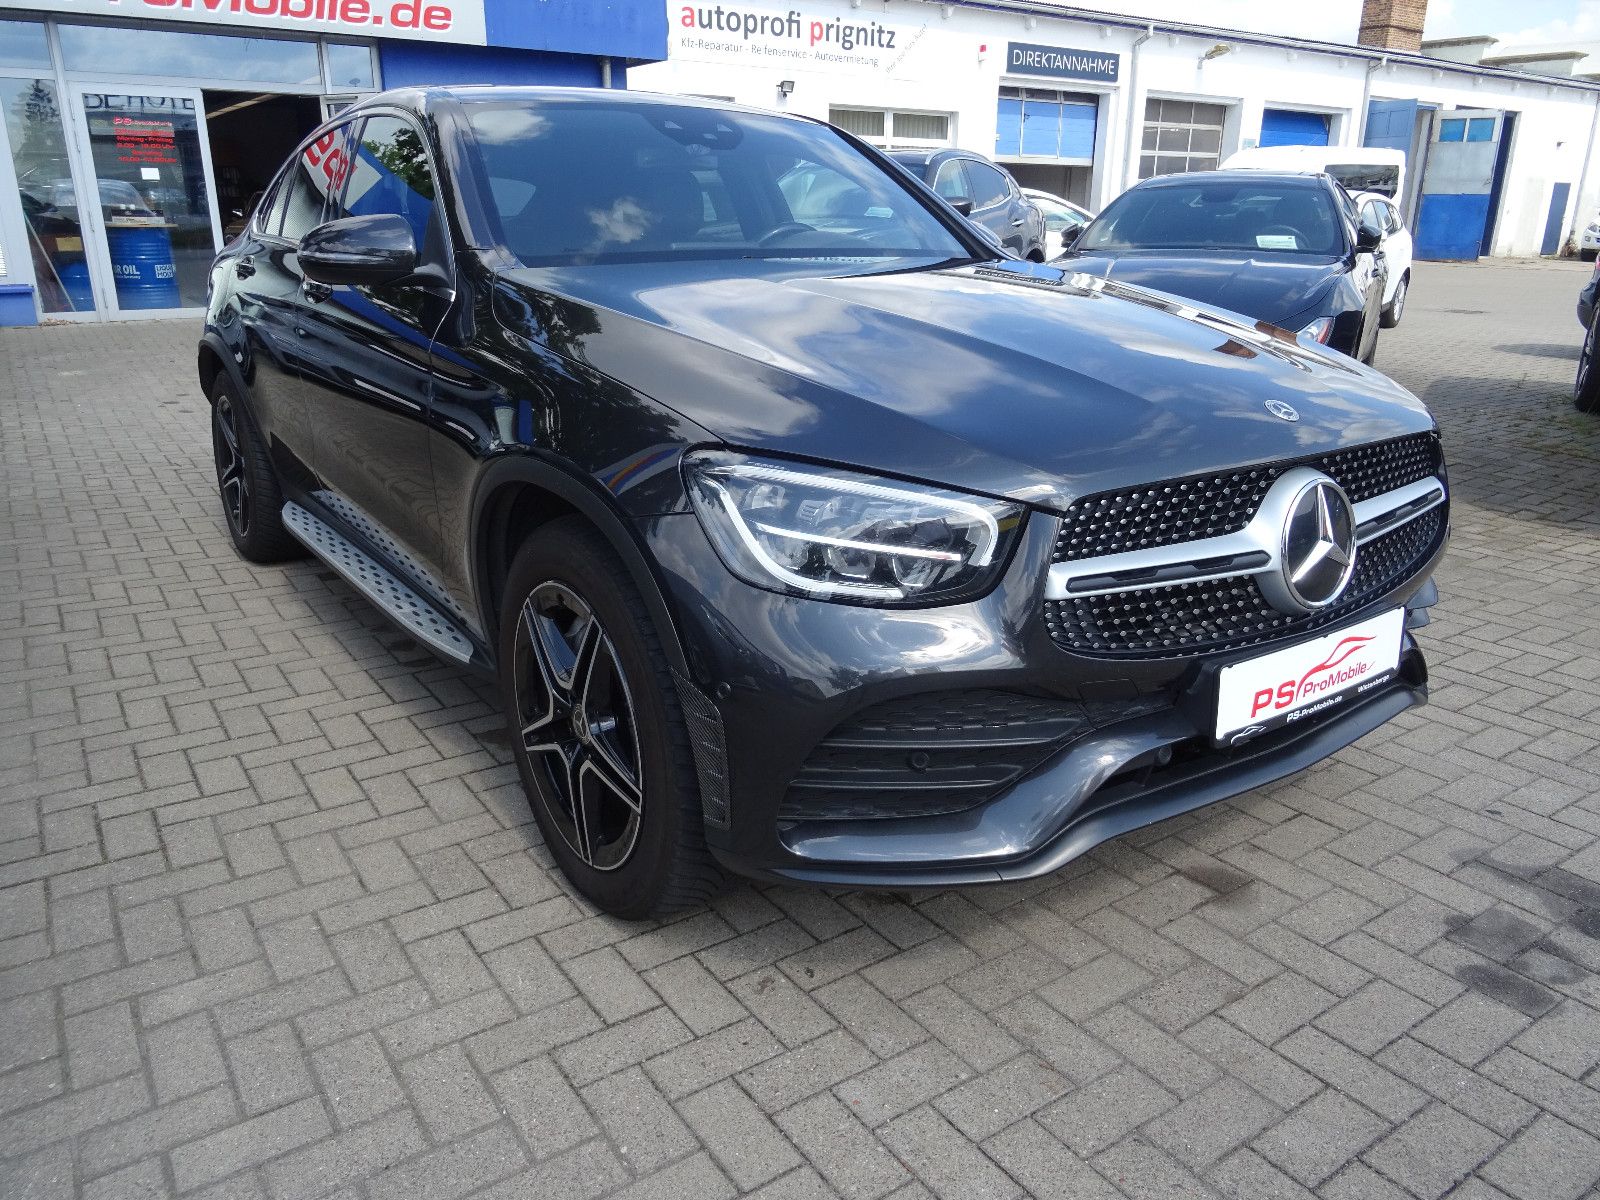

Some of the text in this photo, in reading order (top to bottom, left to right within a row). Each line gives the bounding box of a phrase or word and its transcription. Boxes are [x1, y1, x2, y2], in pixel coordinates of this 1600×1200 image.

[108, 0, 451, 30] obile.de
[681, 5, 895, 50] autoprofi prignitz
[751, 44, 807, 59] Refenservice
[815, 51, 879, 68] Autovermietung
[1013, 49, 1116, 75] DIREKTANNAHME
[123, 264, 141, 275] OIL
[1251, 662, 1367, 719] PS ProMobile
